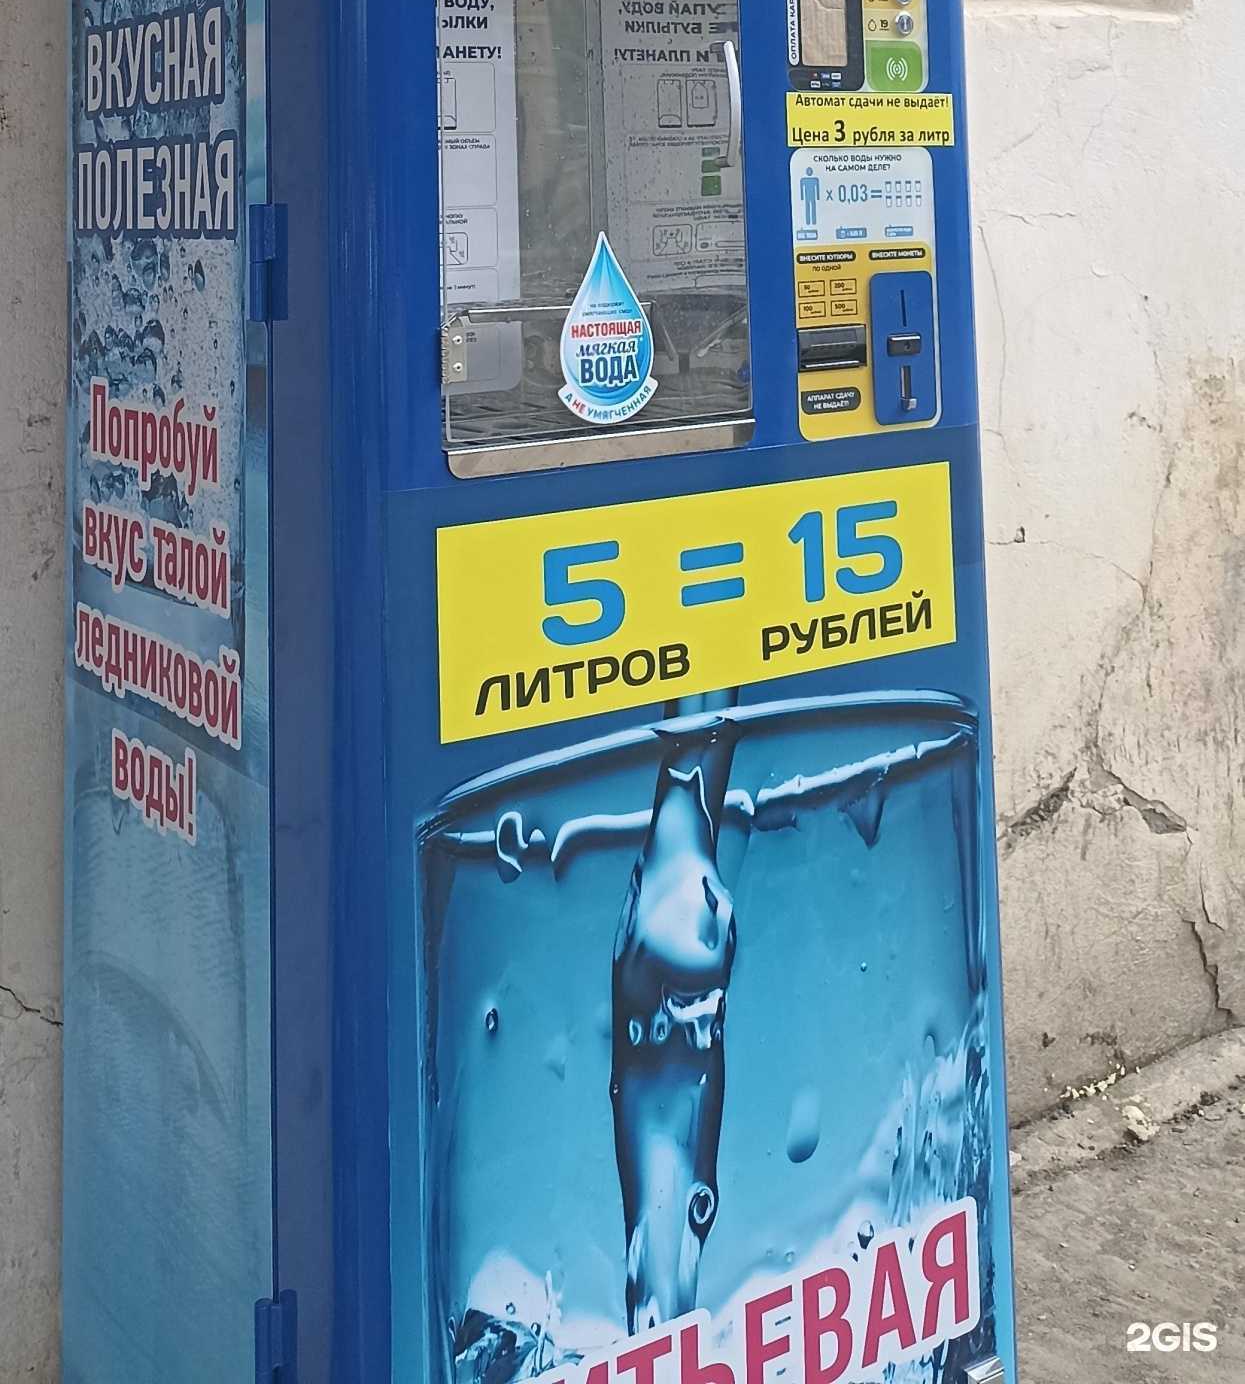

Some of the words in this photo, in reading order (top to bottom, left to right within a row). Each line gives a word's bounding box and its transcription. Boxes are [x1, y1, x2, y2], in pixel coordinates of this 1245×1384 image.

[880, 19, 888, 28] 19
[86, 6, 222, 112] ВКУСНАЯ
[795, 94, 846, 107] Автомат
[849, 96, 884, 109] сдачи
[886, 97, 901, 107] не
[792, 127, 829, 145] Цена
[833, 119, 846, 143] 3
[853, 126, 896, 145] рубля
[899, 130, 914, 142] за
[918, 130, 950, 146] литр
[813, 154, 849, 162] СКОЛЬКО
[850, 154, 872, 162] ВОДЫ
[874, 154, 902, 162] НУЖНО
[838, 164, 866, 172] САМОМ
[78, 139, 235, 230] ПОЛЕЗНАЯ
[838, 184, 868, 205] 0,03
[571, 321, 641, 339] НАСТОЯЩАЯ
[576, 341, 636, 357] мягкая
[580, 355, 637, 385] ВОДА
[565, 393, 573, 403] А
[572, 399, 586, 414] НЕ
[91, 383, 219, 497] Попробуй
[84, 505, 145, 586] вкус
[152, 526, 228, 610] талой
[542, 540, 626, 645] 5
[680, 542, 745, 607] =
[787, 500, 903, 603] 15
[475, 642, 691, 716] ЛИТРОВ
[761, 589, 933, 661] РУБЛЕЙ
[76, 608, 239, 741] ледниковой
[114, 735, 194, 836] воды!
